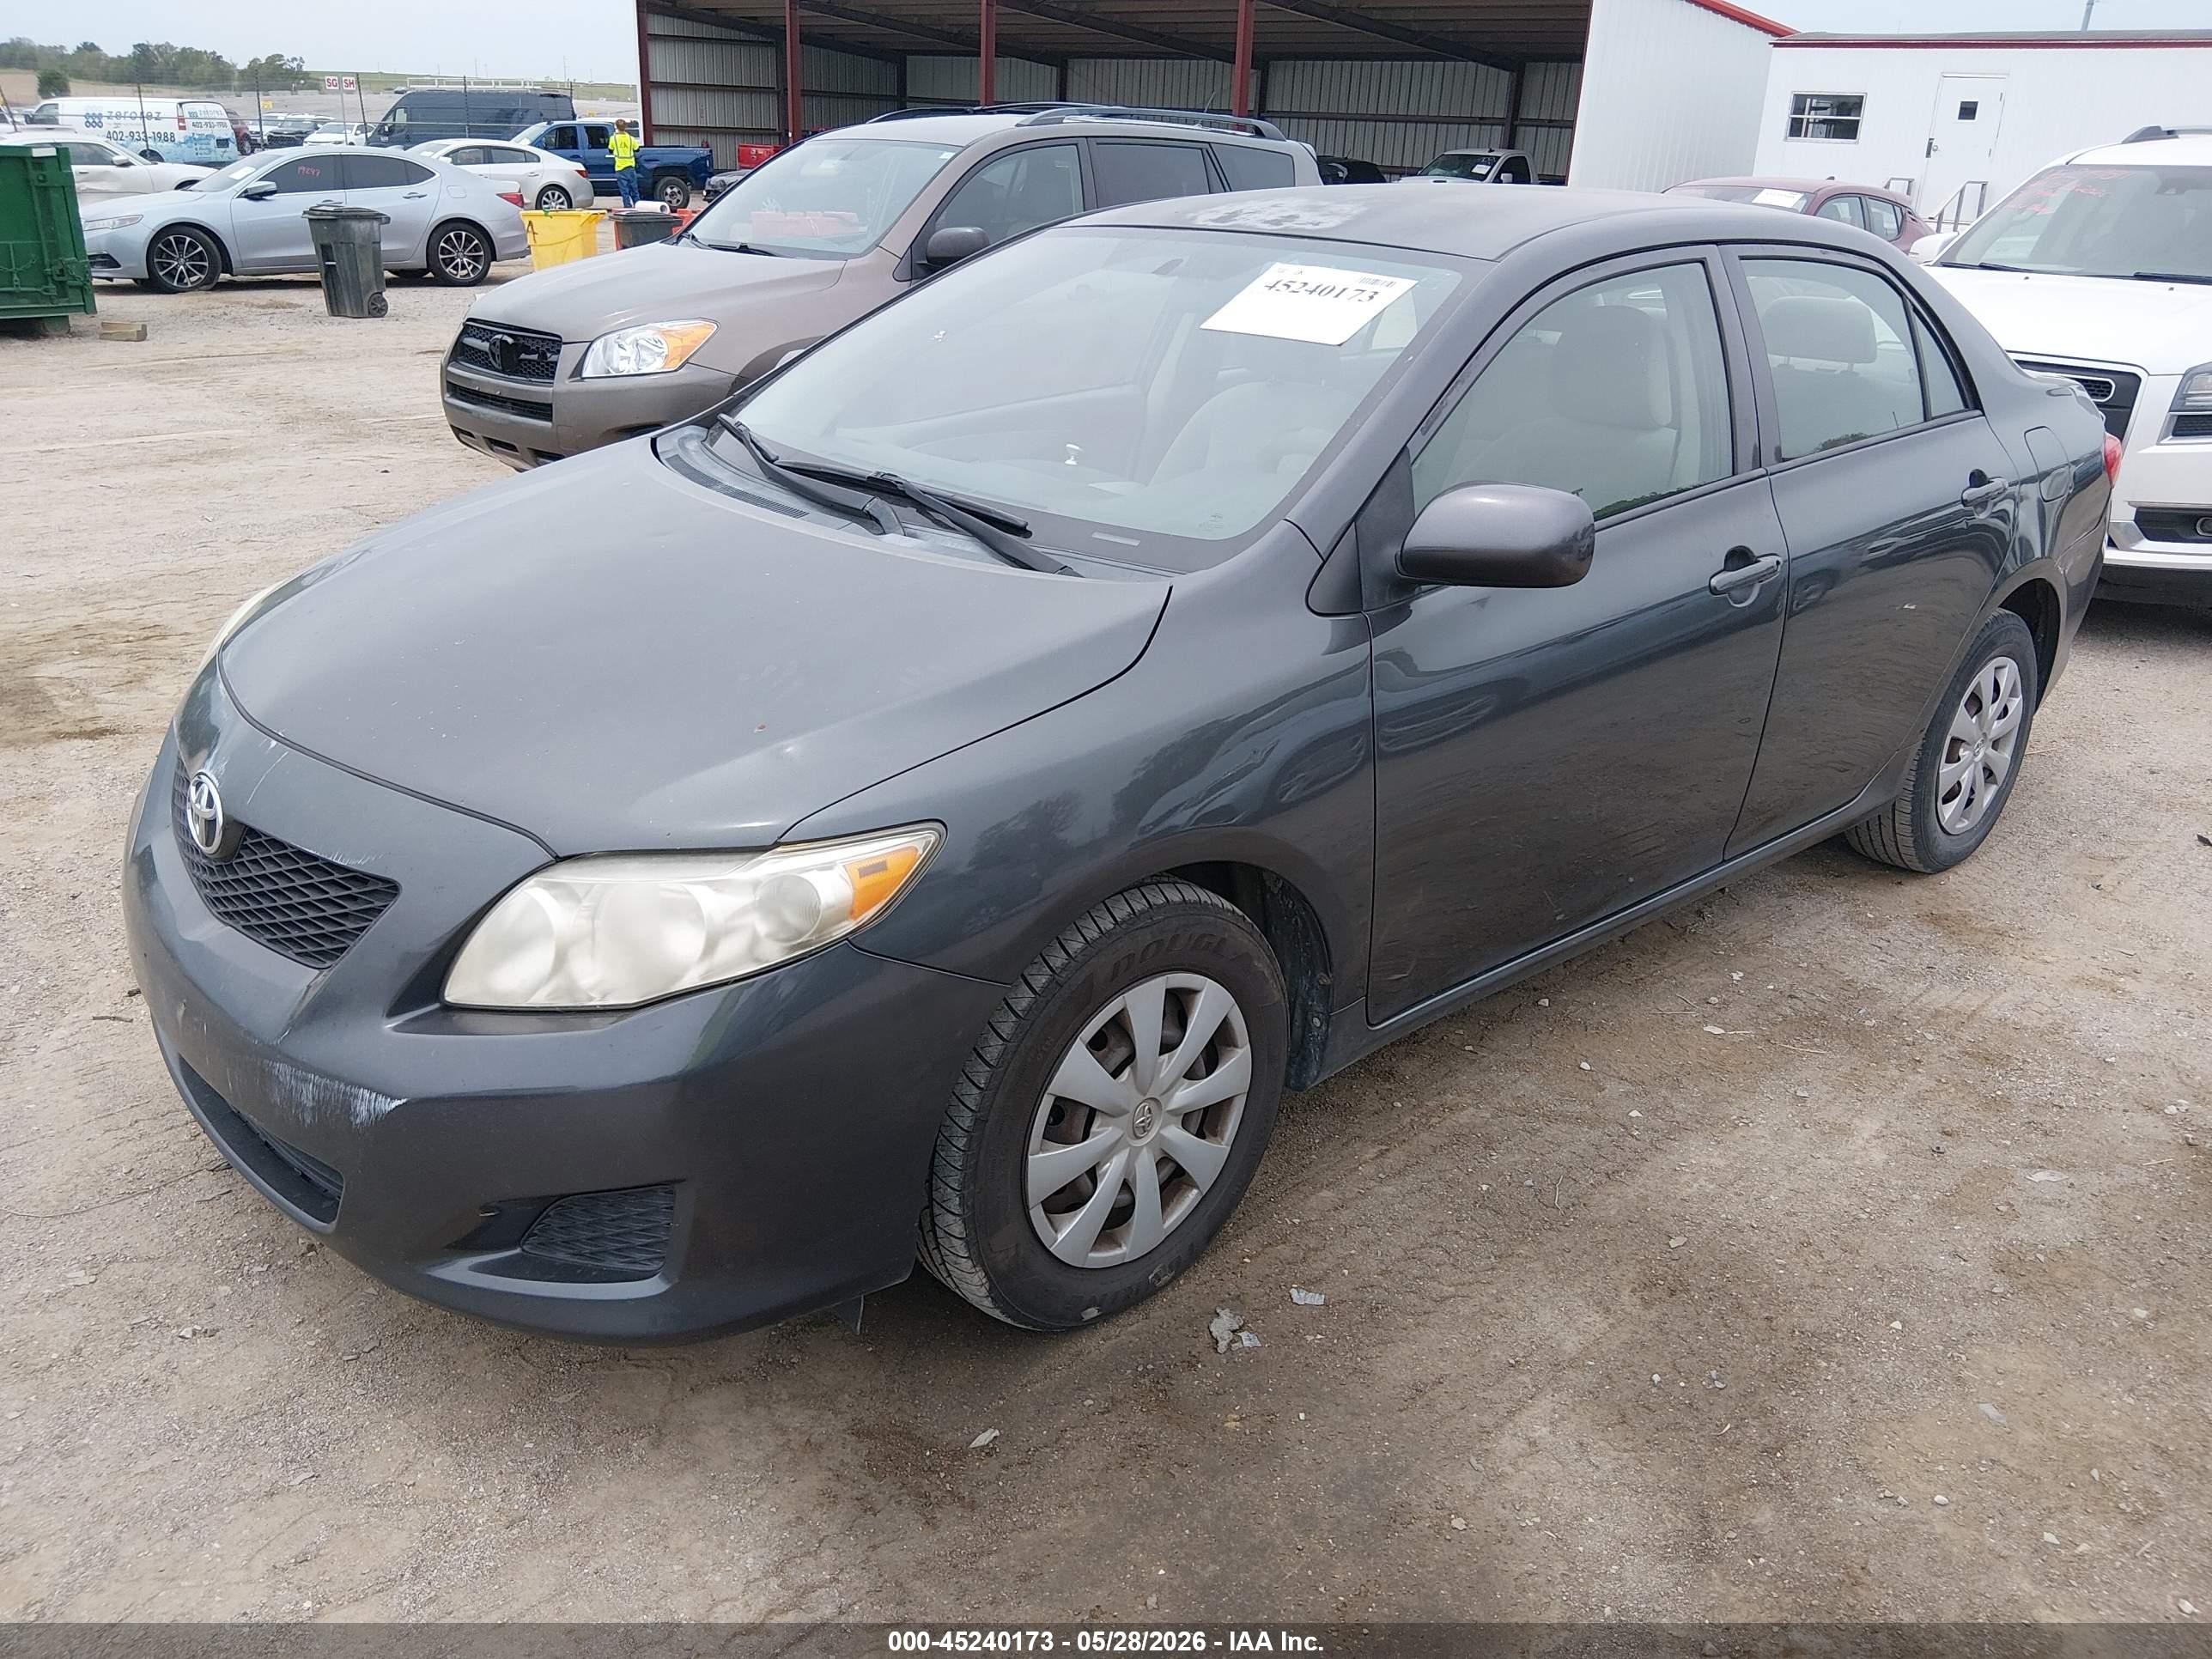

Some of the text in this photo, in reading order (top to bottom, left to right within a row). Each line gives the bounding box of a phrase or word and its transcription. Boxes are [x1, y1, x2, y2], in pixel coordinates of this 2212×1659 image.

[326, 77, 338, 88] SG
[343, 78, 356, 88] SH
[106, 131, 176, 143] 402-933-1988
[1264, 279, 1379, 302] 45240173
